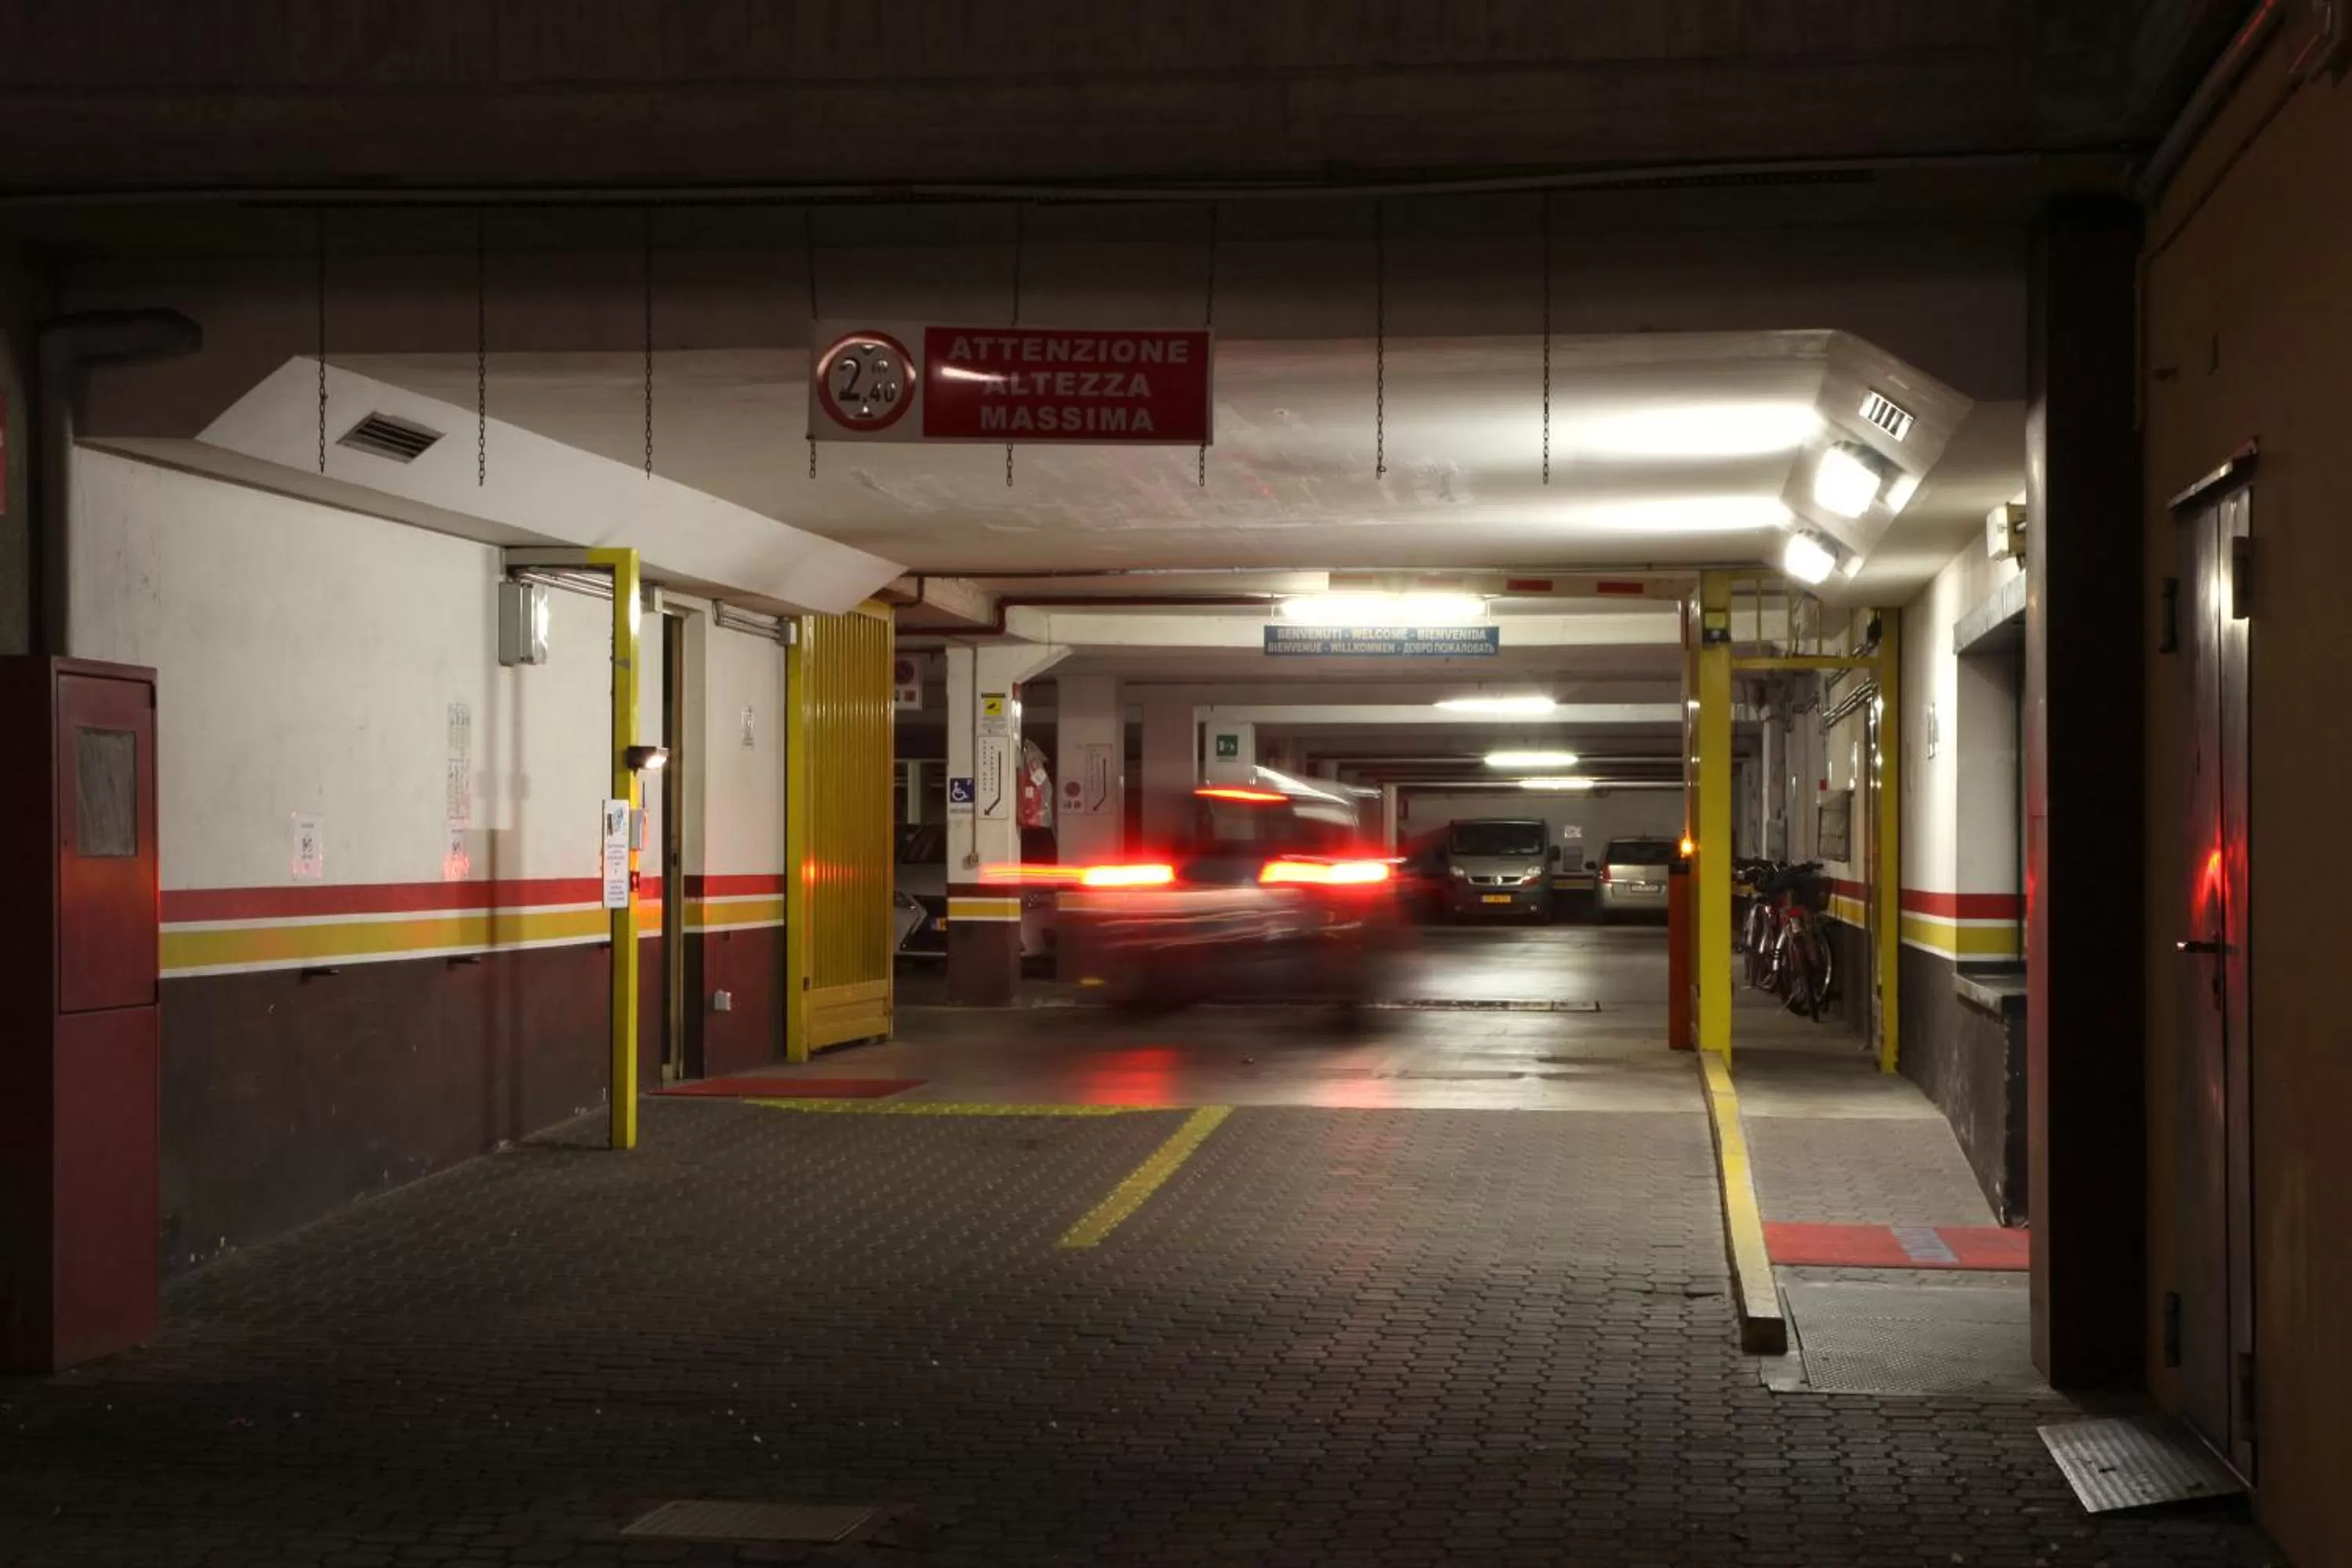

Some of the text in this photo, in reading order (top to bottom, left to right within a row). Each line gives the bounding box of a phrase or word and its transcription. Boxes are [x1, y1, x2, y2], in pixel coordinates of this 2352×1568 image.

[947, 336, 1189, 364] ATTENZIONE
[983, 372, 1152, 398] ALTEZZA
[981, 405, 1154, 432] MASSIMA
[1352, 628, 1408, 641] WELCOME
